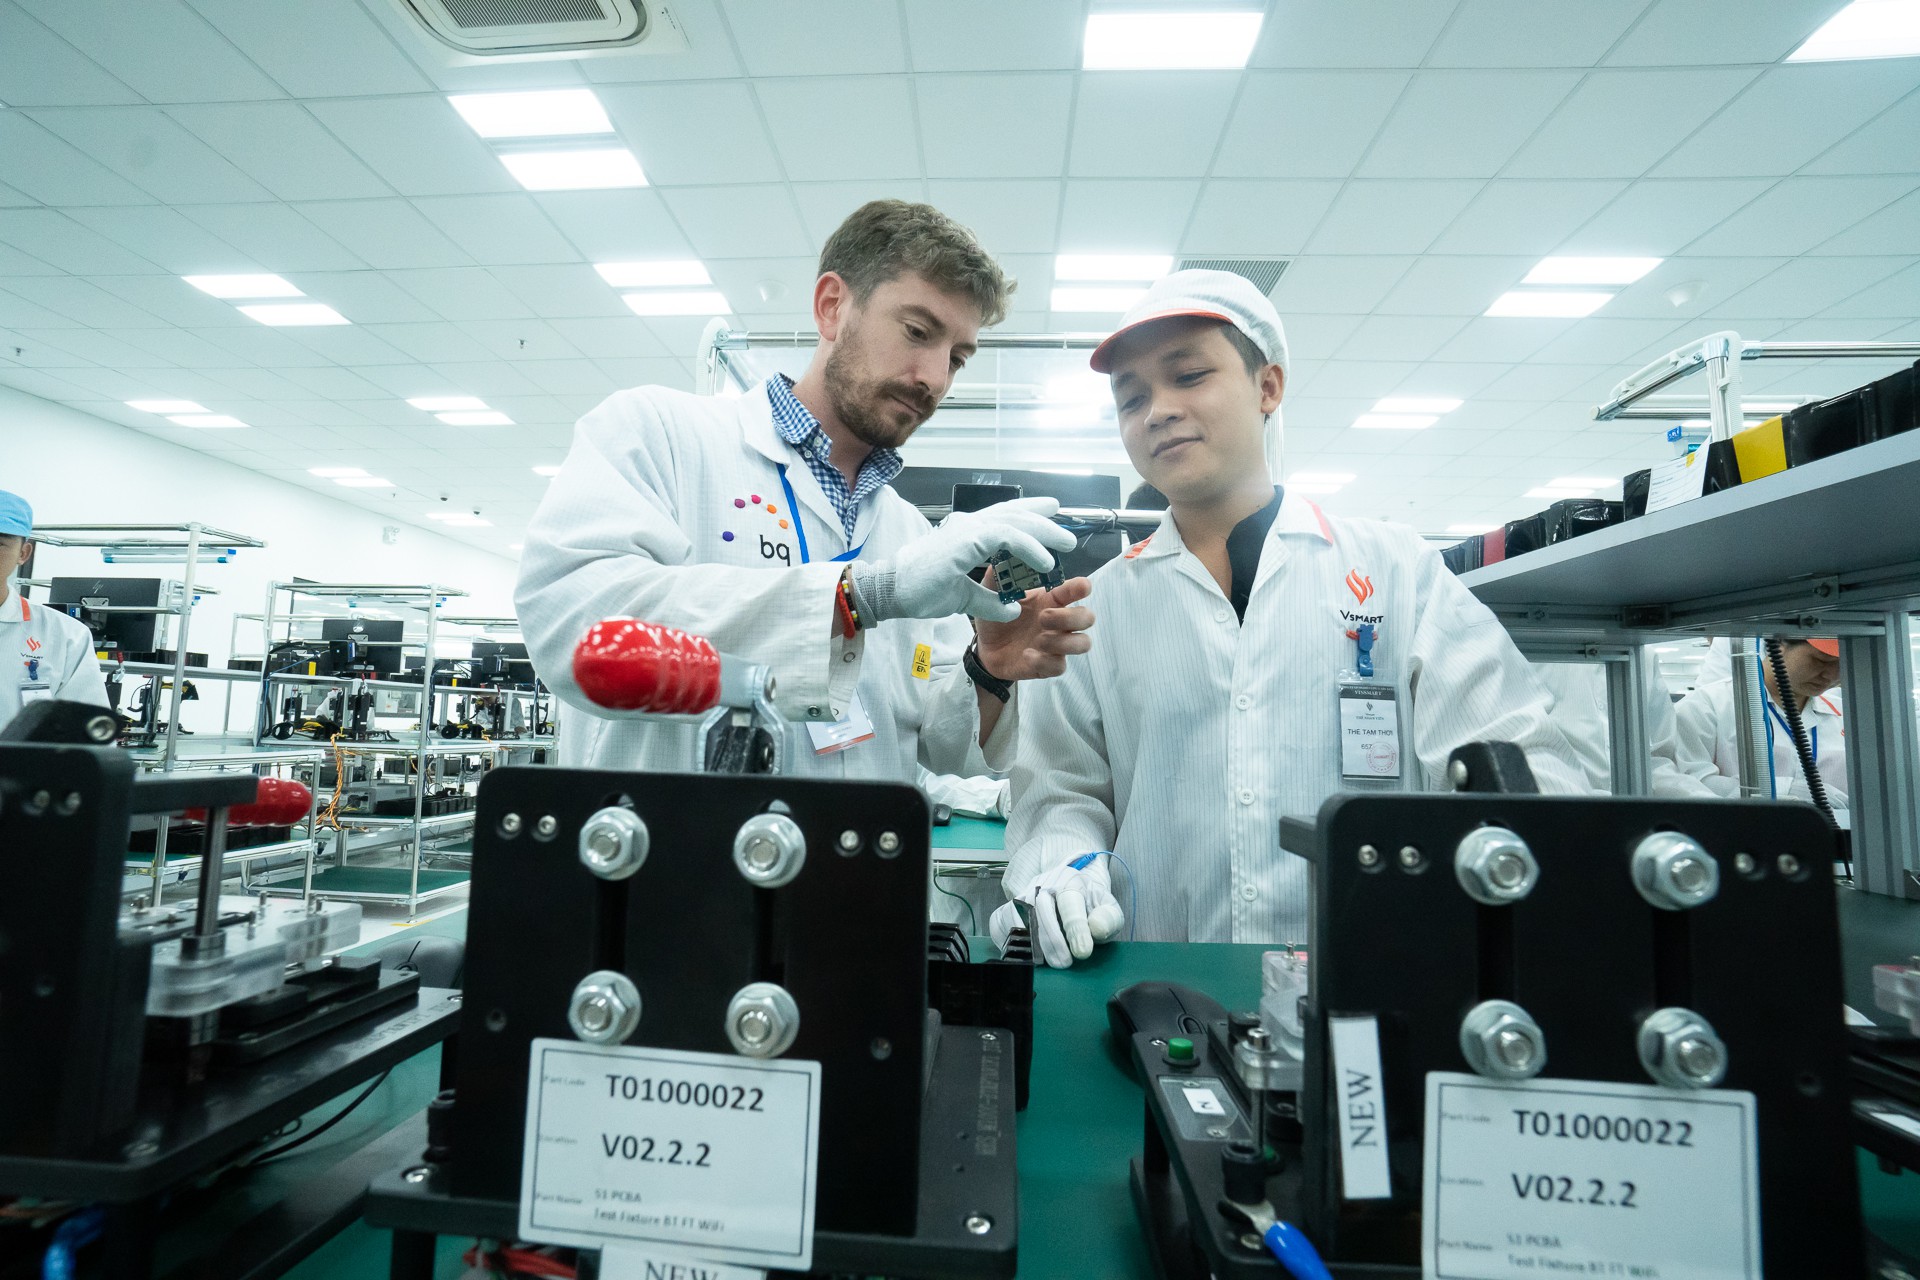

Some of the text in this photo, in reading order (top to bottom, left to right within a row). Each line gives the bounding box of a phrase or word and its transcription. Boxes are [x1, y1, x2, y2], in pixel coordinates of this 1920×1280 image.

[760, 534, 791, 567] bq
[605, 1073, 765, 1113] T01000022
[1346, 1069, 1378, 1148] NEW
[1512, 1109, 1694, 1147] T01000022
[601, 1133, 712, 1168] V02.2.2
[1511, 1173, 1638, 1208] V02.2.2
